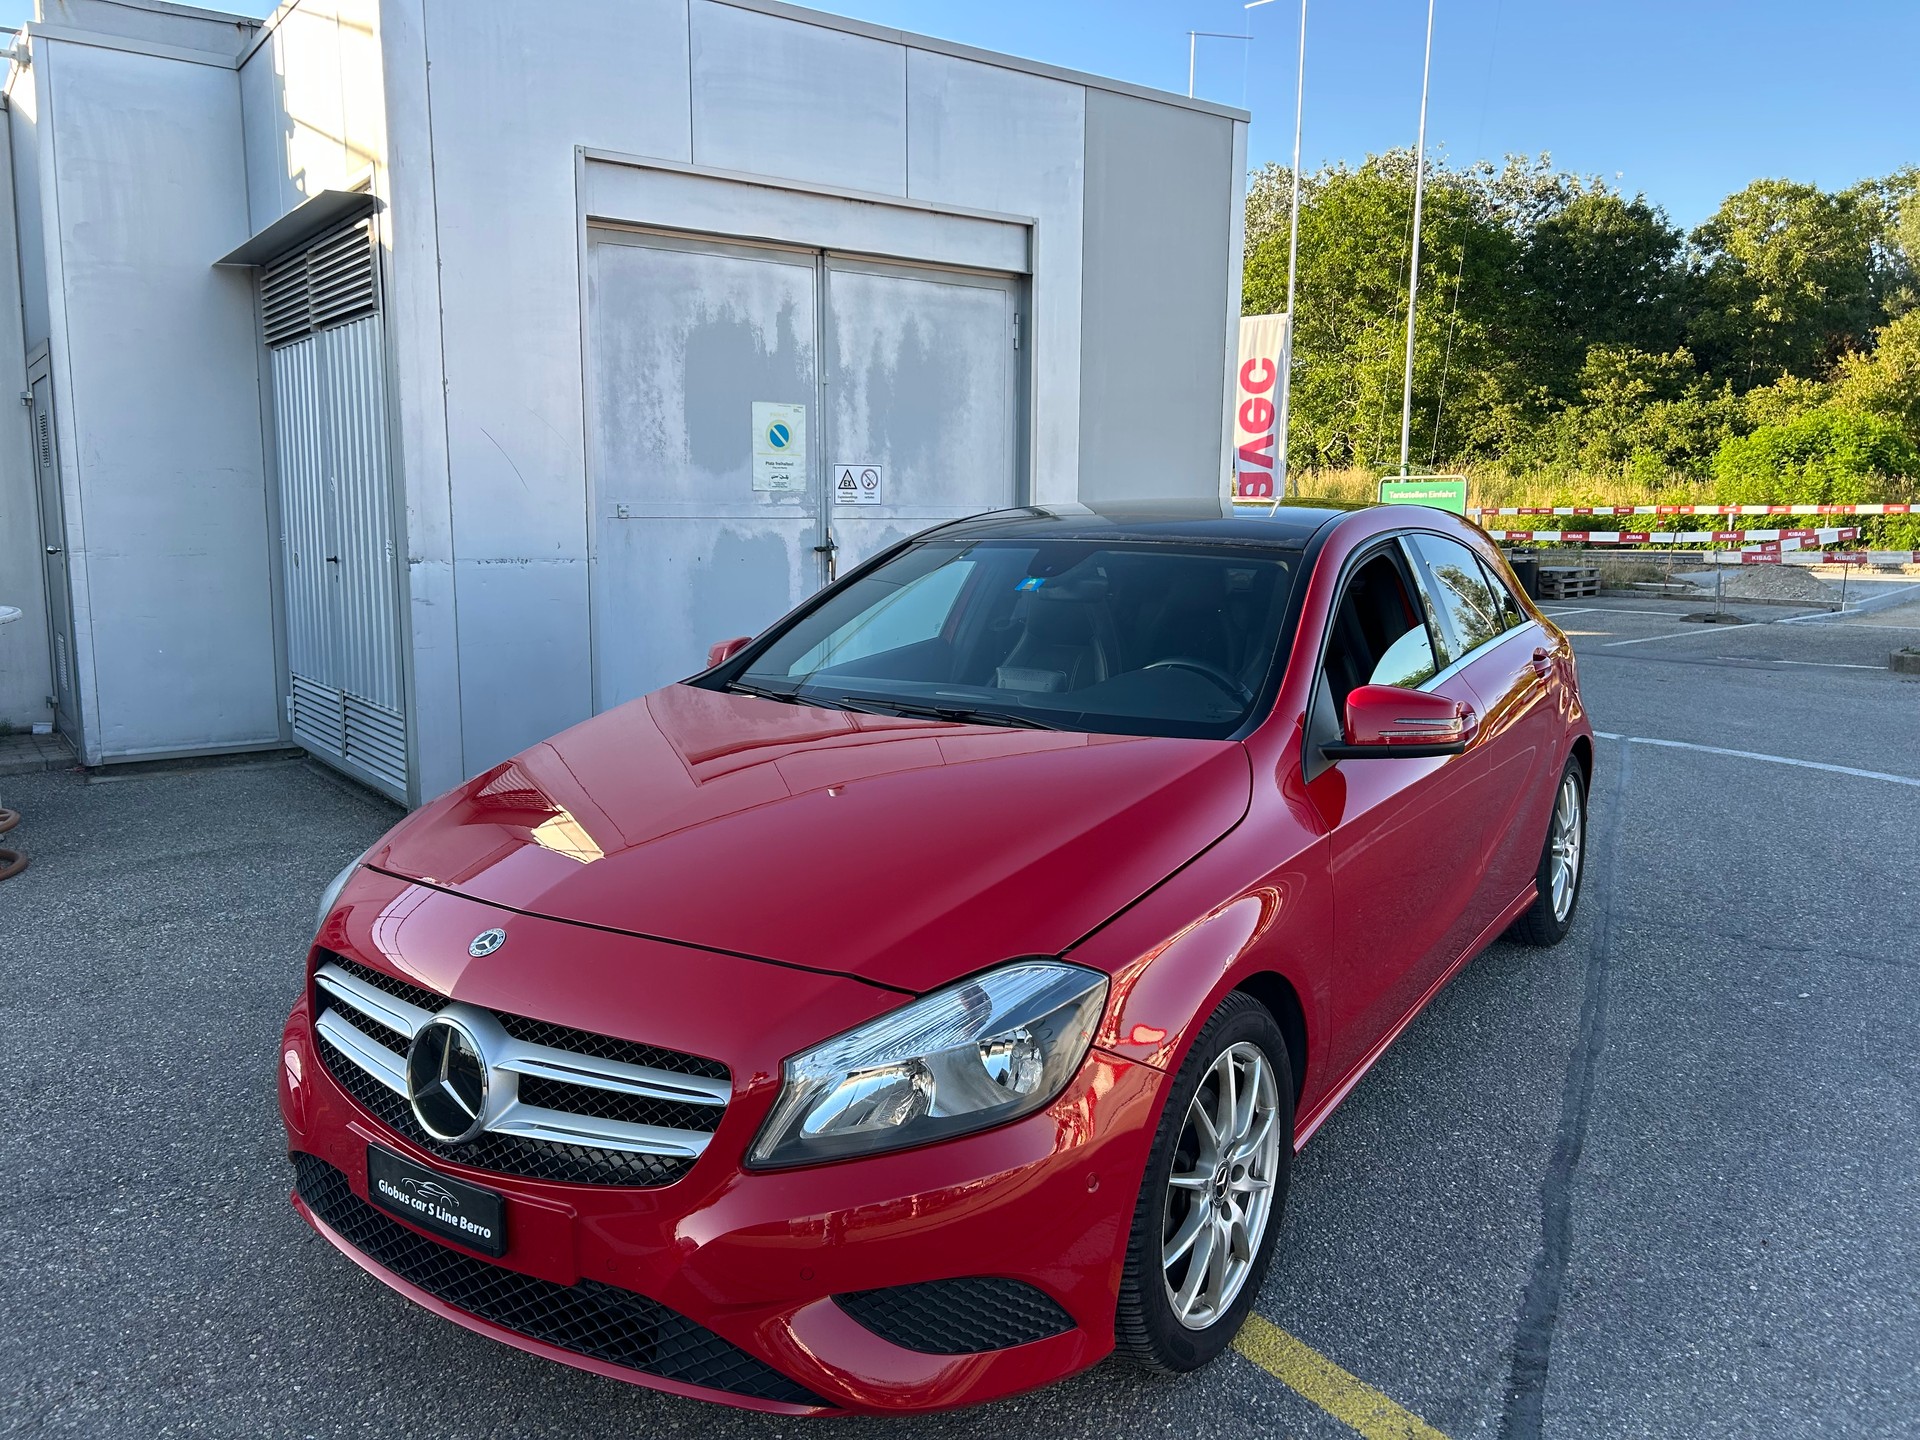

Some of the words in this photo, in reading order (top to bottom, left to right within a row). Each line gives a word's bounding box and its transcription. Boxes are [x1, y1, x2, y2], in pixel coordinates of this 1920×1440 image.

[1428, 490, 1456, 498] Einfahrt
[378, 1179, 410, 1205] Globus
[411, 1197, 427, 1212] car
[428, 1202, 434, 1216] S
[436, 1206, 458, 1226] Line
[460, 1216, 492, 1239] Berro
